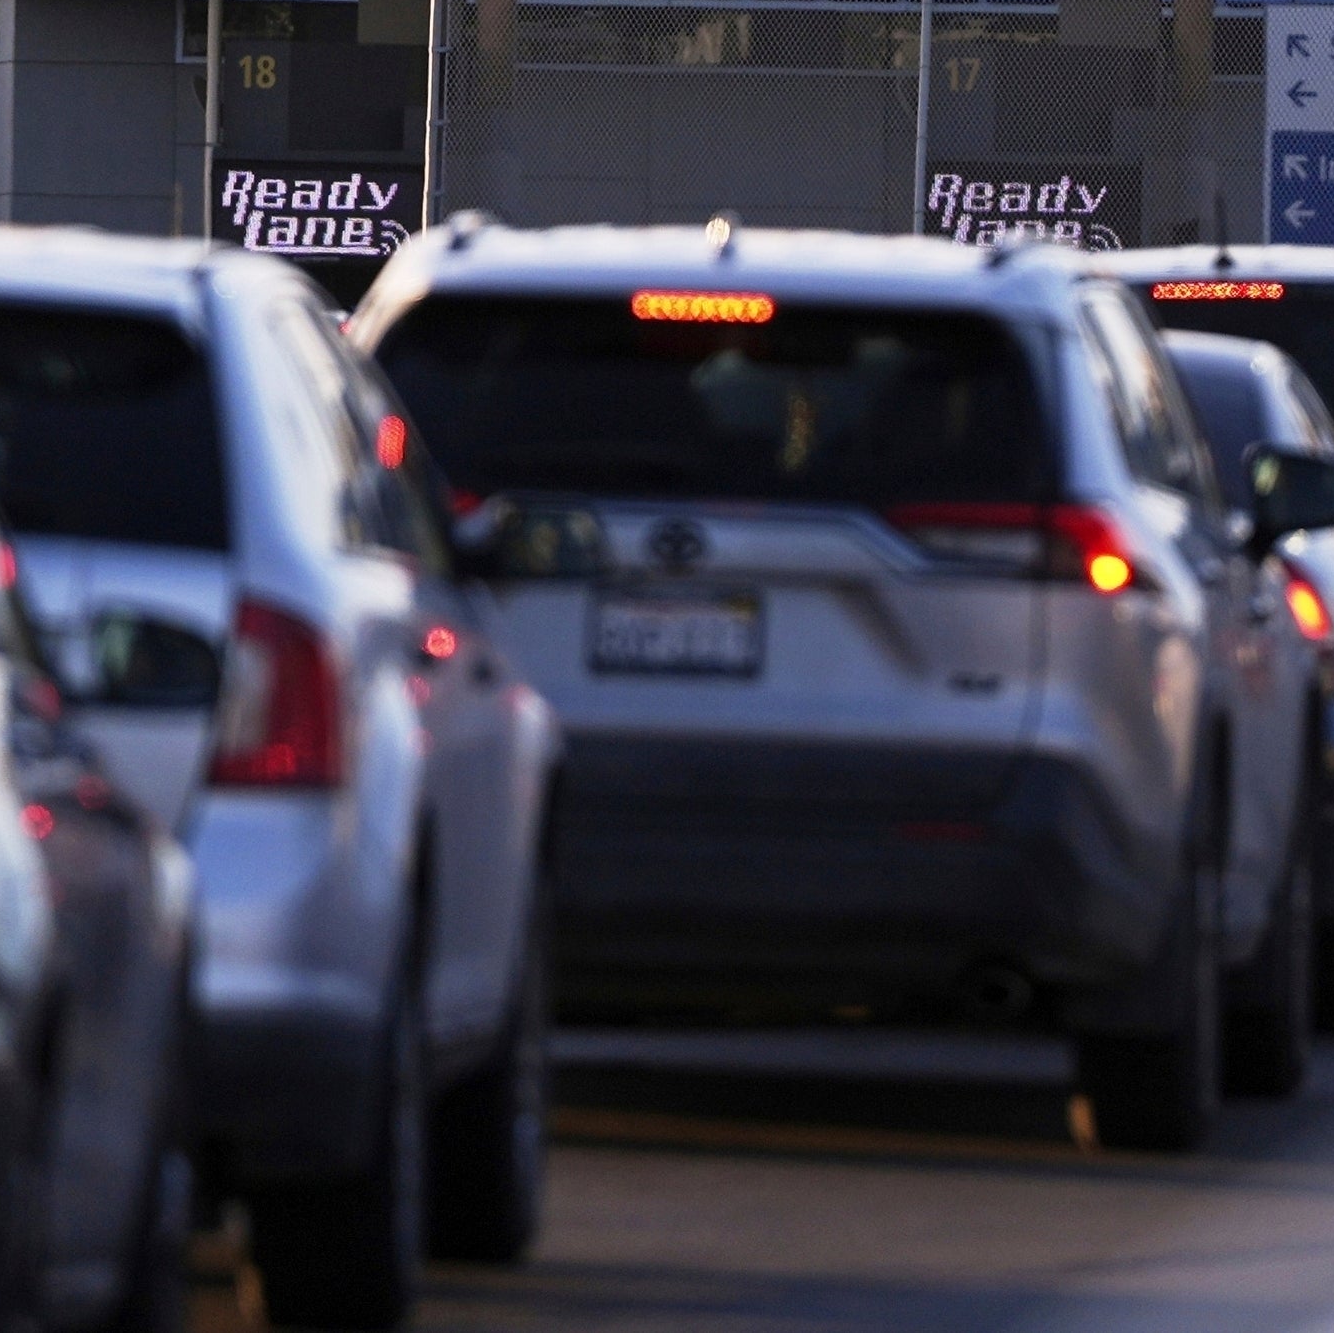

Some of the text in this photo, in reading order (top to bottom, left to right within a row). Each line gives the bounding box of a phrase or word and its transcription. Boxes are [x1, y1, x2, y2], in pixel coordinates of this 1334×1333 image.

[239, 54, 277, 89] 18
[946, 57, 982, 92] 17
[222, 170, 399, 225] Ready
[928, 173, 1107, 228] Ready
